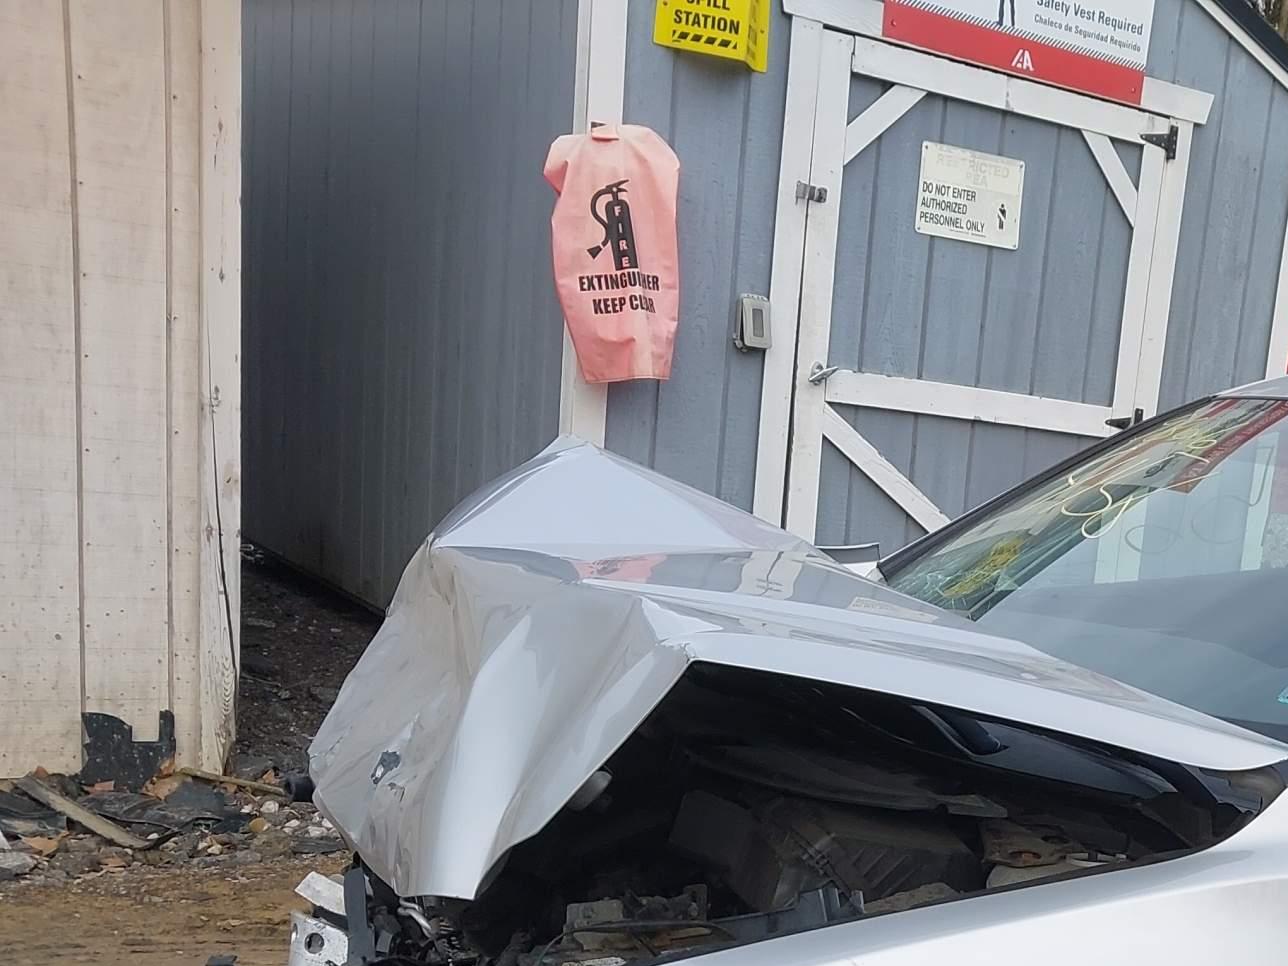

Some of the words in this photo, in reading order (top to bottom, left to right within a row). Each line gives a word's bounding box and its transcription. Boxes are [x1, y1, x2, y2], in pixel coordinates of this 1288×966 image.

[686, 0, 731, 11] ILL
[674, 9, 741, 36] STATION
[1034, 13, 1063, 31] Chaleco
[1063, 23, 1073, 33] de
[1074, 25, 1109, 44] Seguridad
[1074, 2, 1095, 22] Vest
[1098, 10, 1144, 36] Required
[922, 181, 934, 194] DO
[934, 183, 951, 197] NOT
[952, 187, 977, 202] ENTER
[921, 197, 968, 215] AUTHORIZED
[919, 211, 964, 230] PERSONNEL
[965, 219, 986, 233] ONLY
[614, 205, 631, 268] FIRE
[592, 297, 627, 315] KEEP
